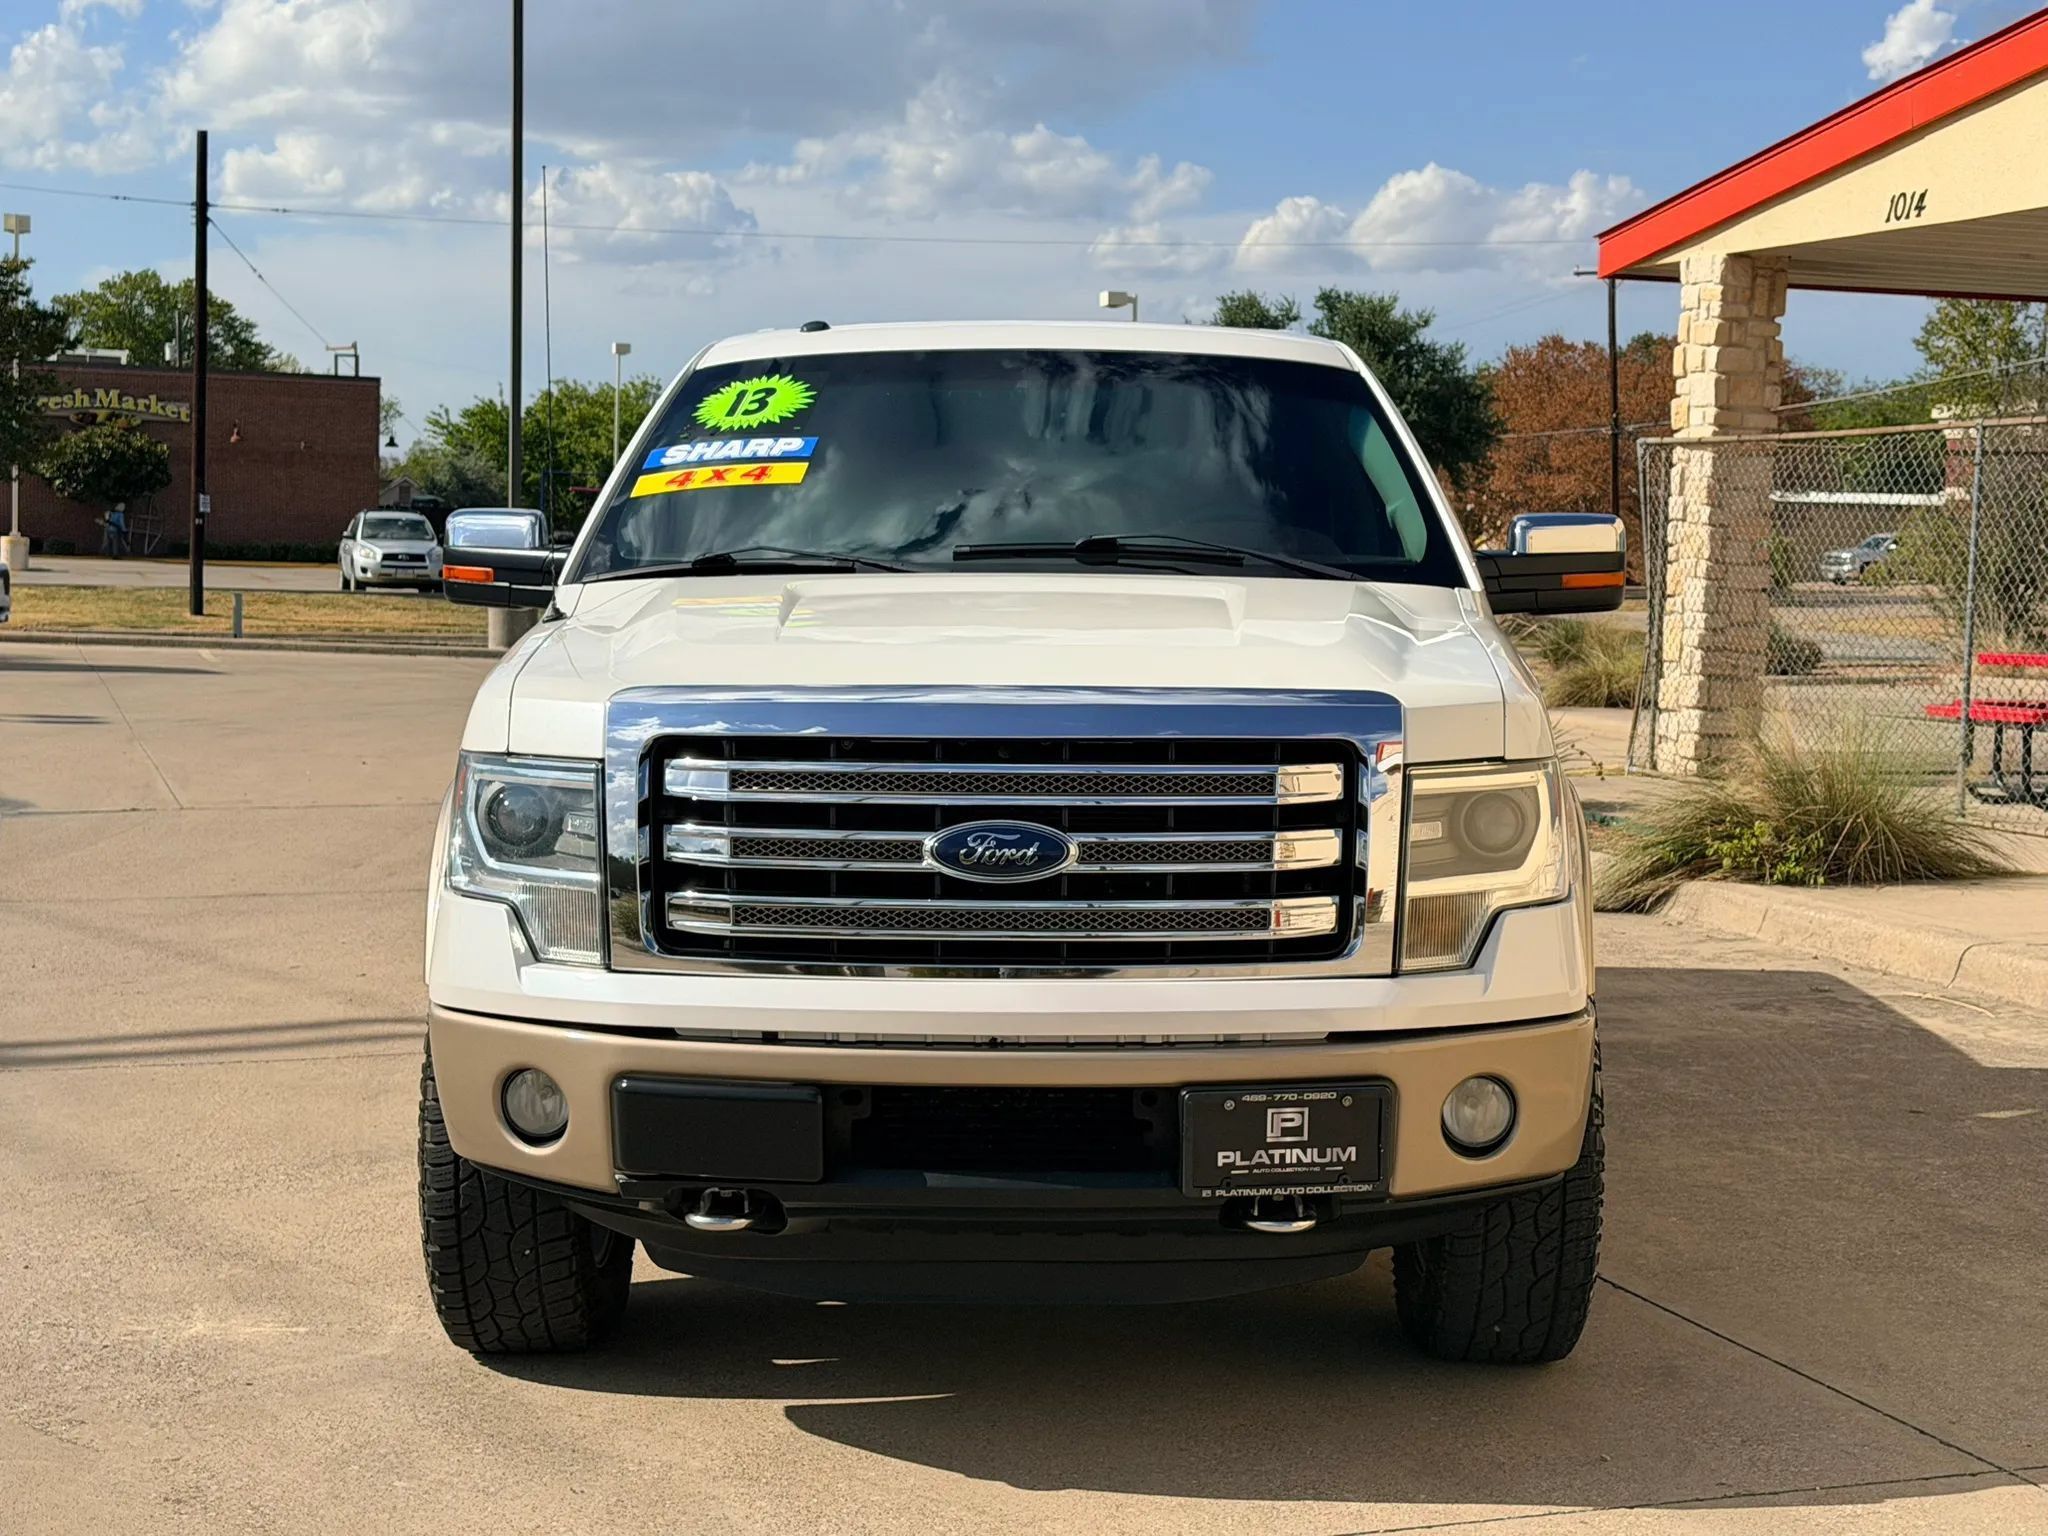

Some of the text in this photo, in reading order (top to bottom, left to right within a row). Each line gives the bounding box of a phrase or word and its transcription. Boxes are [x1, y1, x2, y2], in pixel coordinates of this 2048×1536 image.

[1885, 188, 1928, 224] 1014
[94, 388, 191, 422] Market
[724, 387, 777, 418] 13
[660, 437, 804, 466] SHARP
[958, 831, 1042, 865] Ford
[1217, 1146, 1357, 1167] PLATINUM
[1215, 1184, 1373, 1197] PLATINUM AUTO COLLECTION
